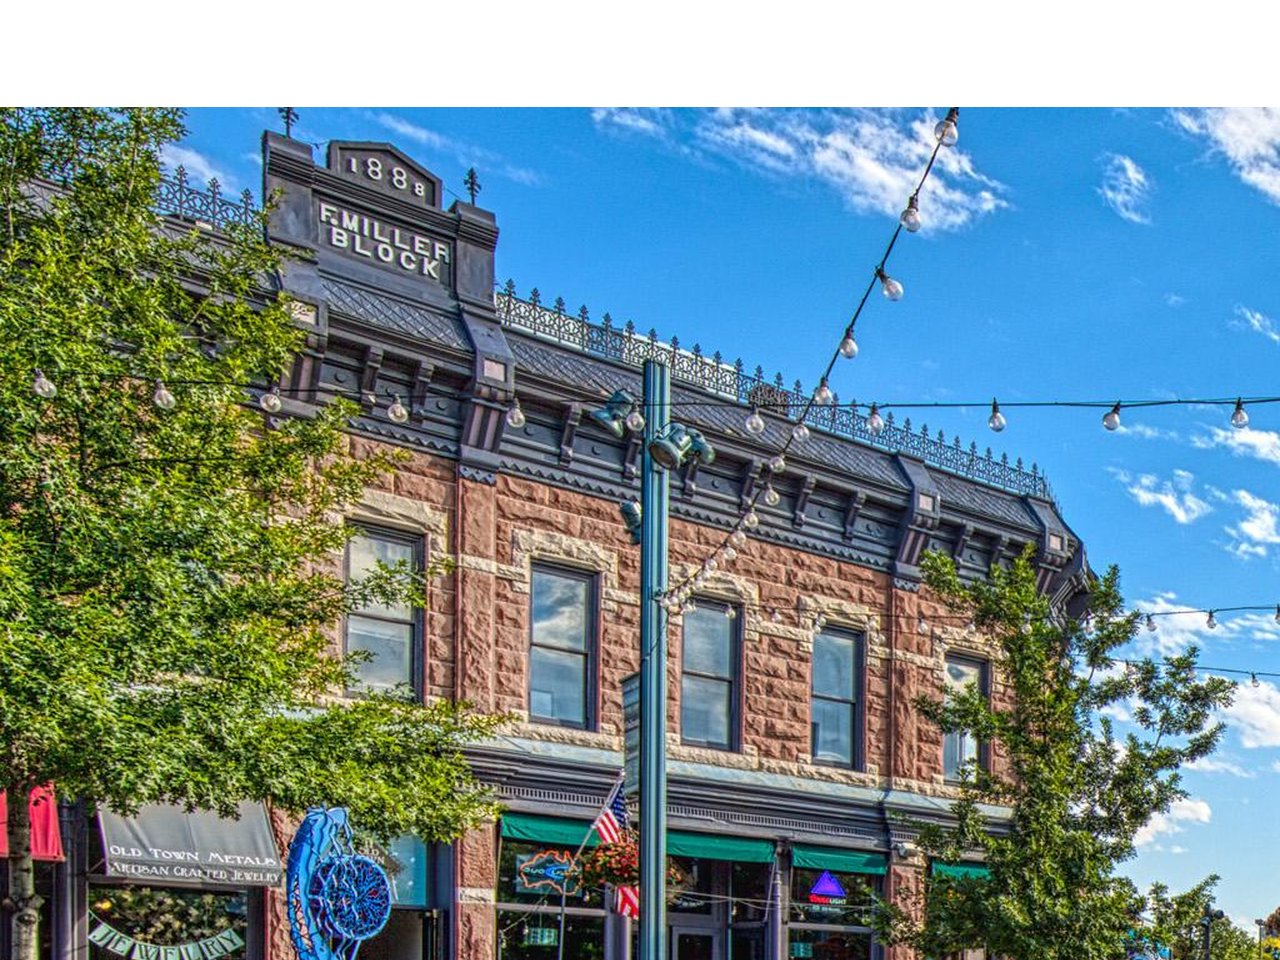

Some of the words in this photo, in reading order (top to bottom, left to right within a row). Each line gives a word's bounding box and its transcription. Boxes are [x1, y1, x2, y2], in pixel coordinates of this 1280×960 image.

[350, 157, 425, 196] 1888
[331, 226, 440, 279] BLOCK
[109, 845, 142, 857] OLD
[150, 848, 199, 860] TOWN
[208, 852, 276, 866] METALS
[111, 862, 169, 875] ARTISAN
[231, 870, 281, 882] JEWELRY
